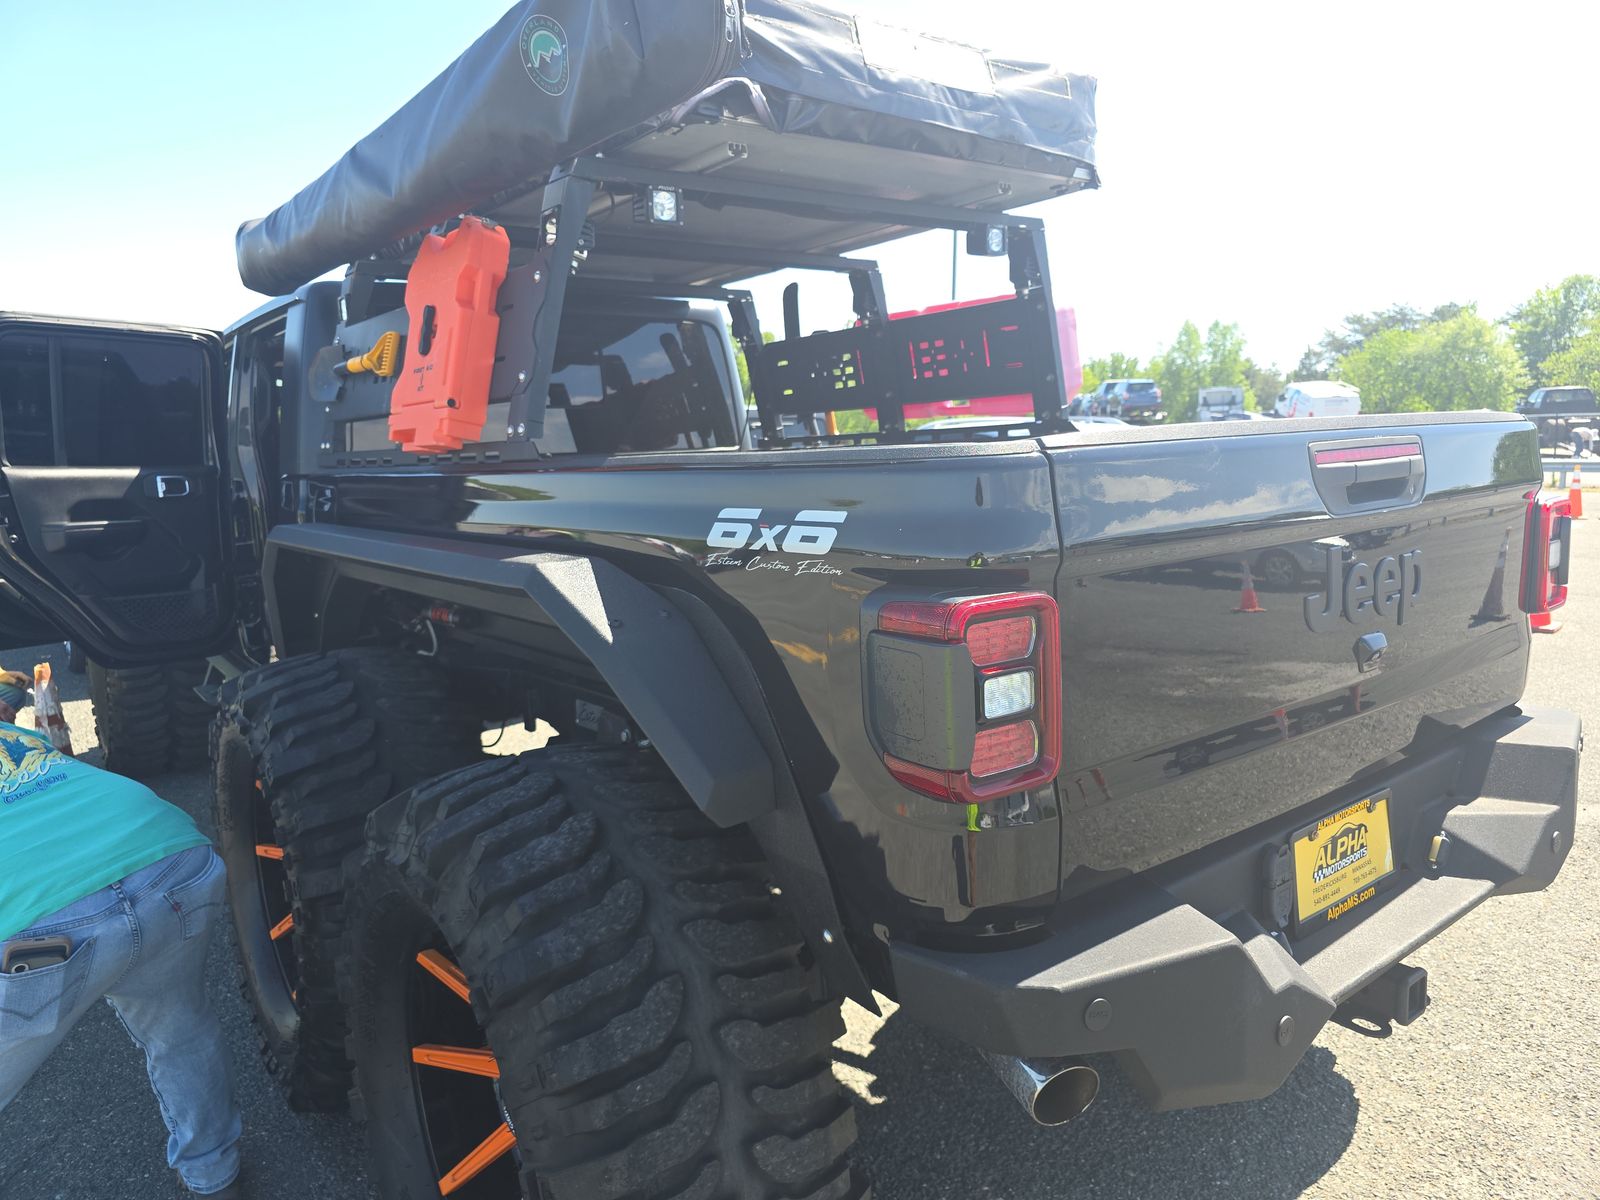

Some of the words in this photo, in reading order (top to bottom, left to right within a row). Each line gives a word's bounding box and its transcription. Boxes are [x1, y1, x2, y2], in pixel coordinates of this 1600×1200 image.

[706, 507, 848, 555] 6x6
[705, 549, 743, 567] Esteem
[745, 556, 791, 571] Custom
[794, 559, 844, 576] Edition
[1303, 546, 1423, 633] Jeep
[1317, 813, 1336, 831] ALPHA
[1335, 799, 1371, 822] MOTORSPORTS
[1314, 826, 1368, 872] ALPHA
[1323, 846, 1368, 879] MOTORSPORTS
[1327, 885, 1376, 921] AlphaMS.com
